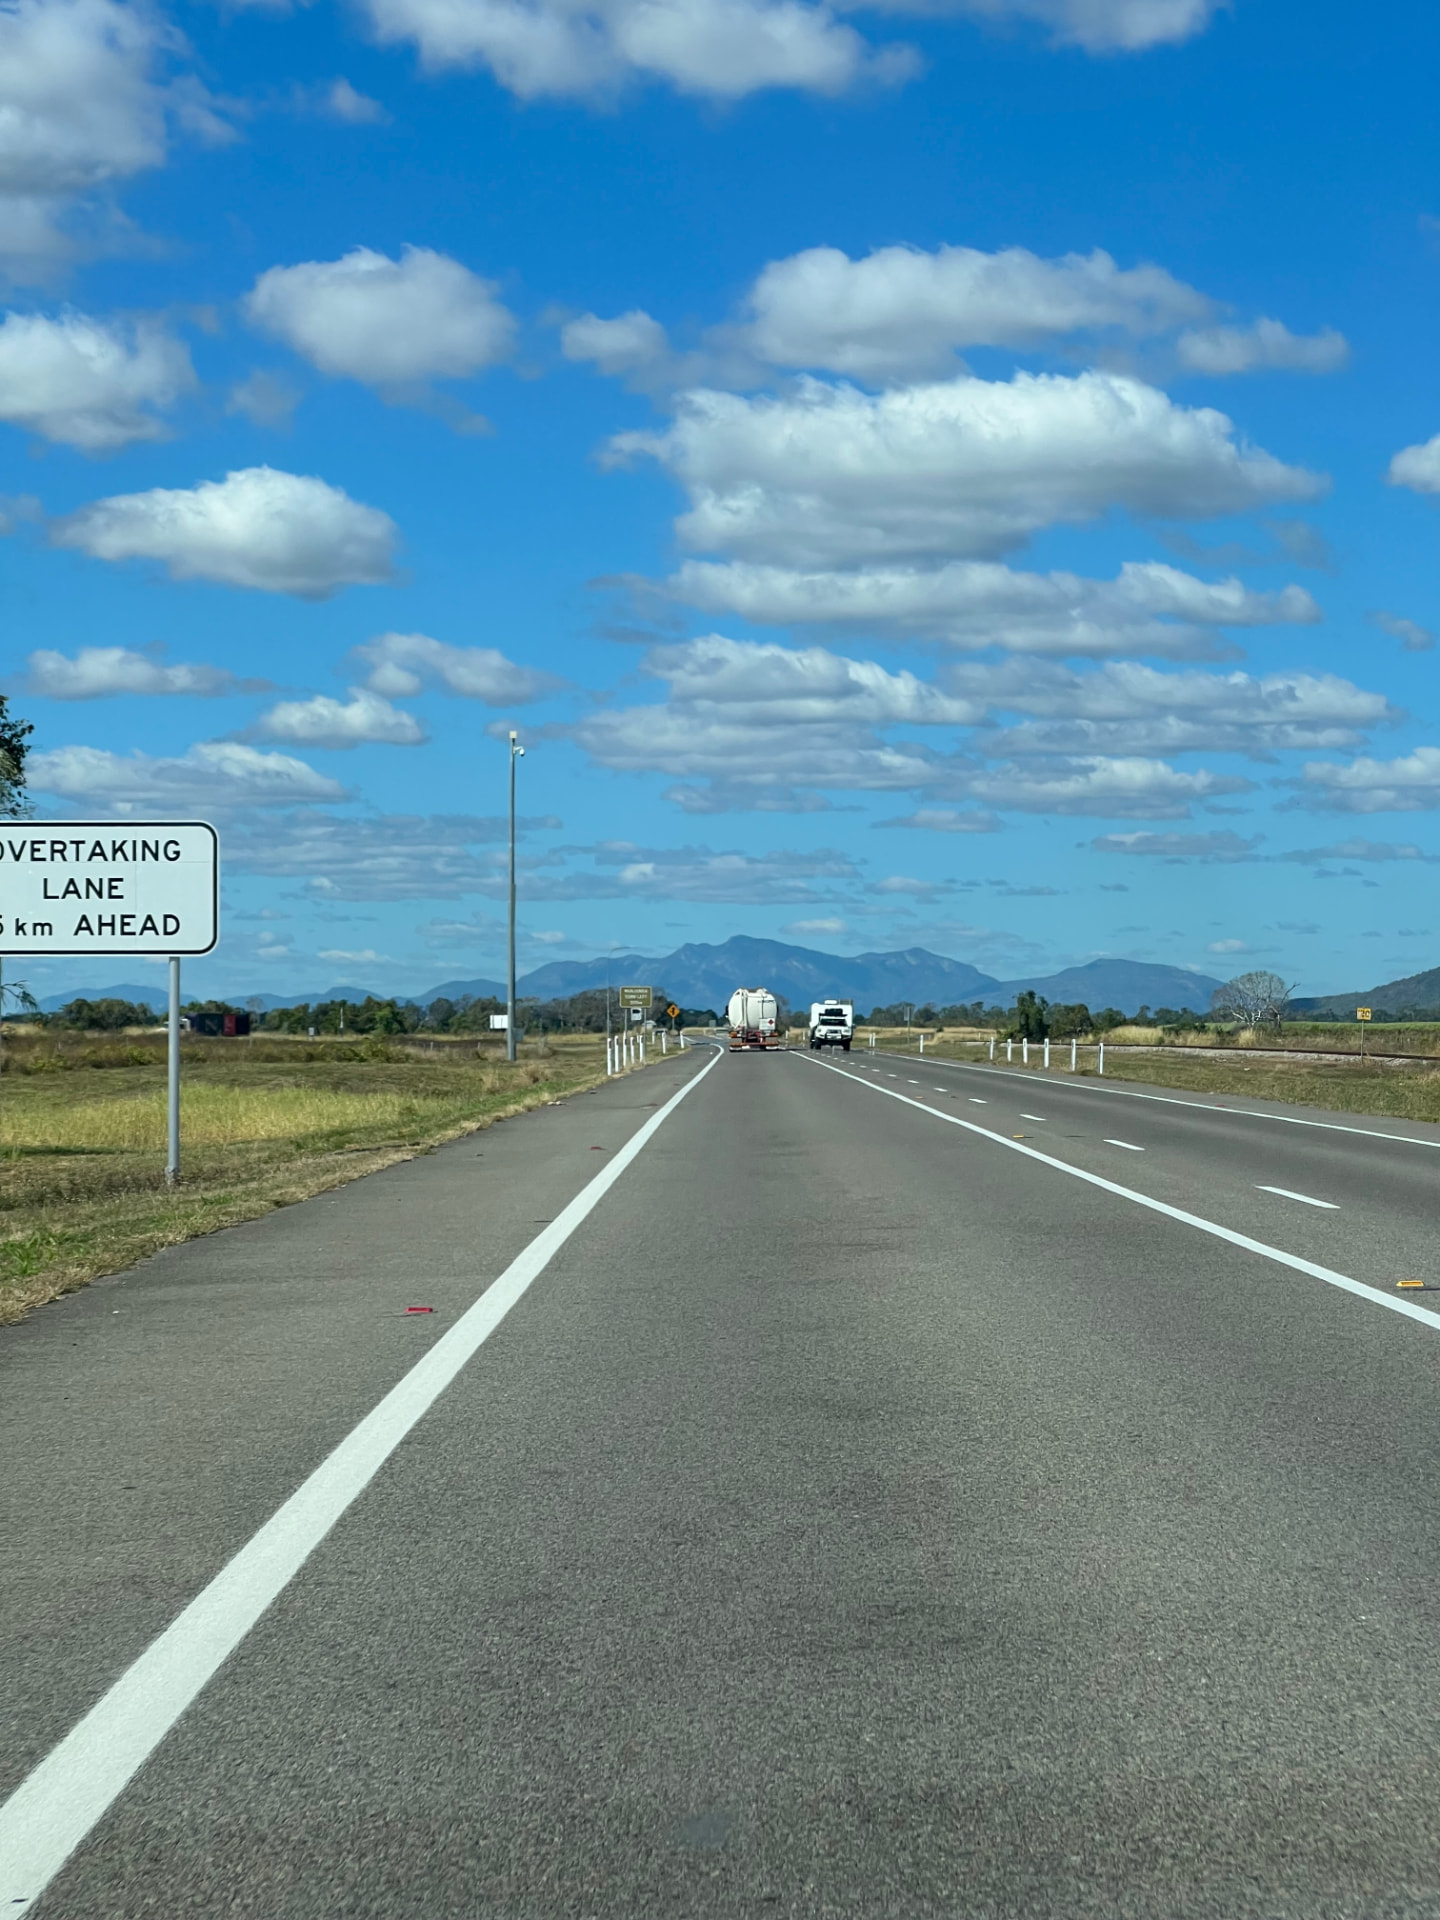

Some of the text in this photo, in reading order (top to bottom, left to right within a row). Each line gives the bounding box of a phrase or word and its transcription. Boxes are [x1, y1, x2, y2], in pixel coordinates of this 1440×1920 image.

[0, 839, 181, 862] VERTAKING
[43, 877, 124, 900] LANE
[14, 917, 53, 936] km
[73, 914, 180, 936] AHEAD
